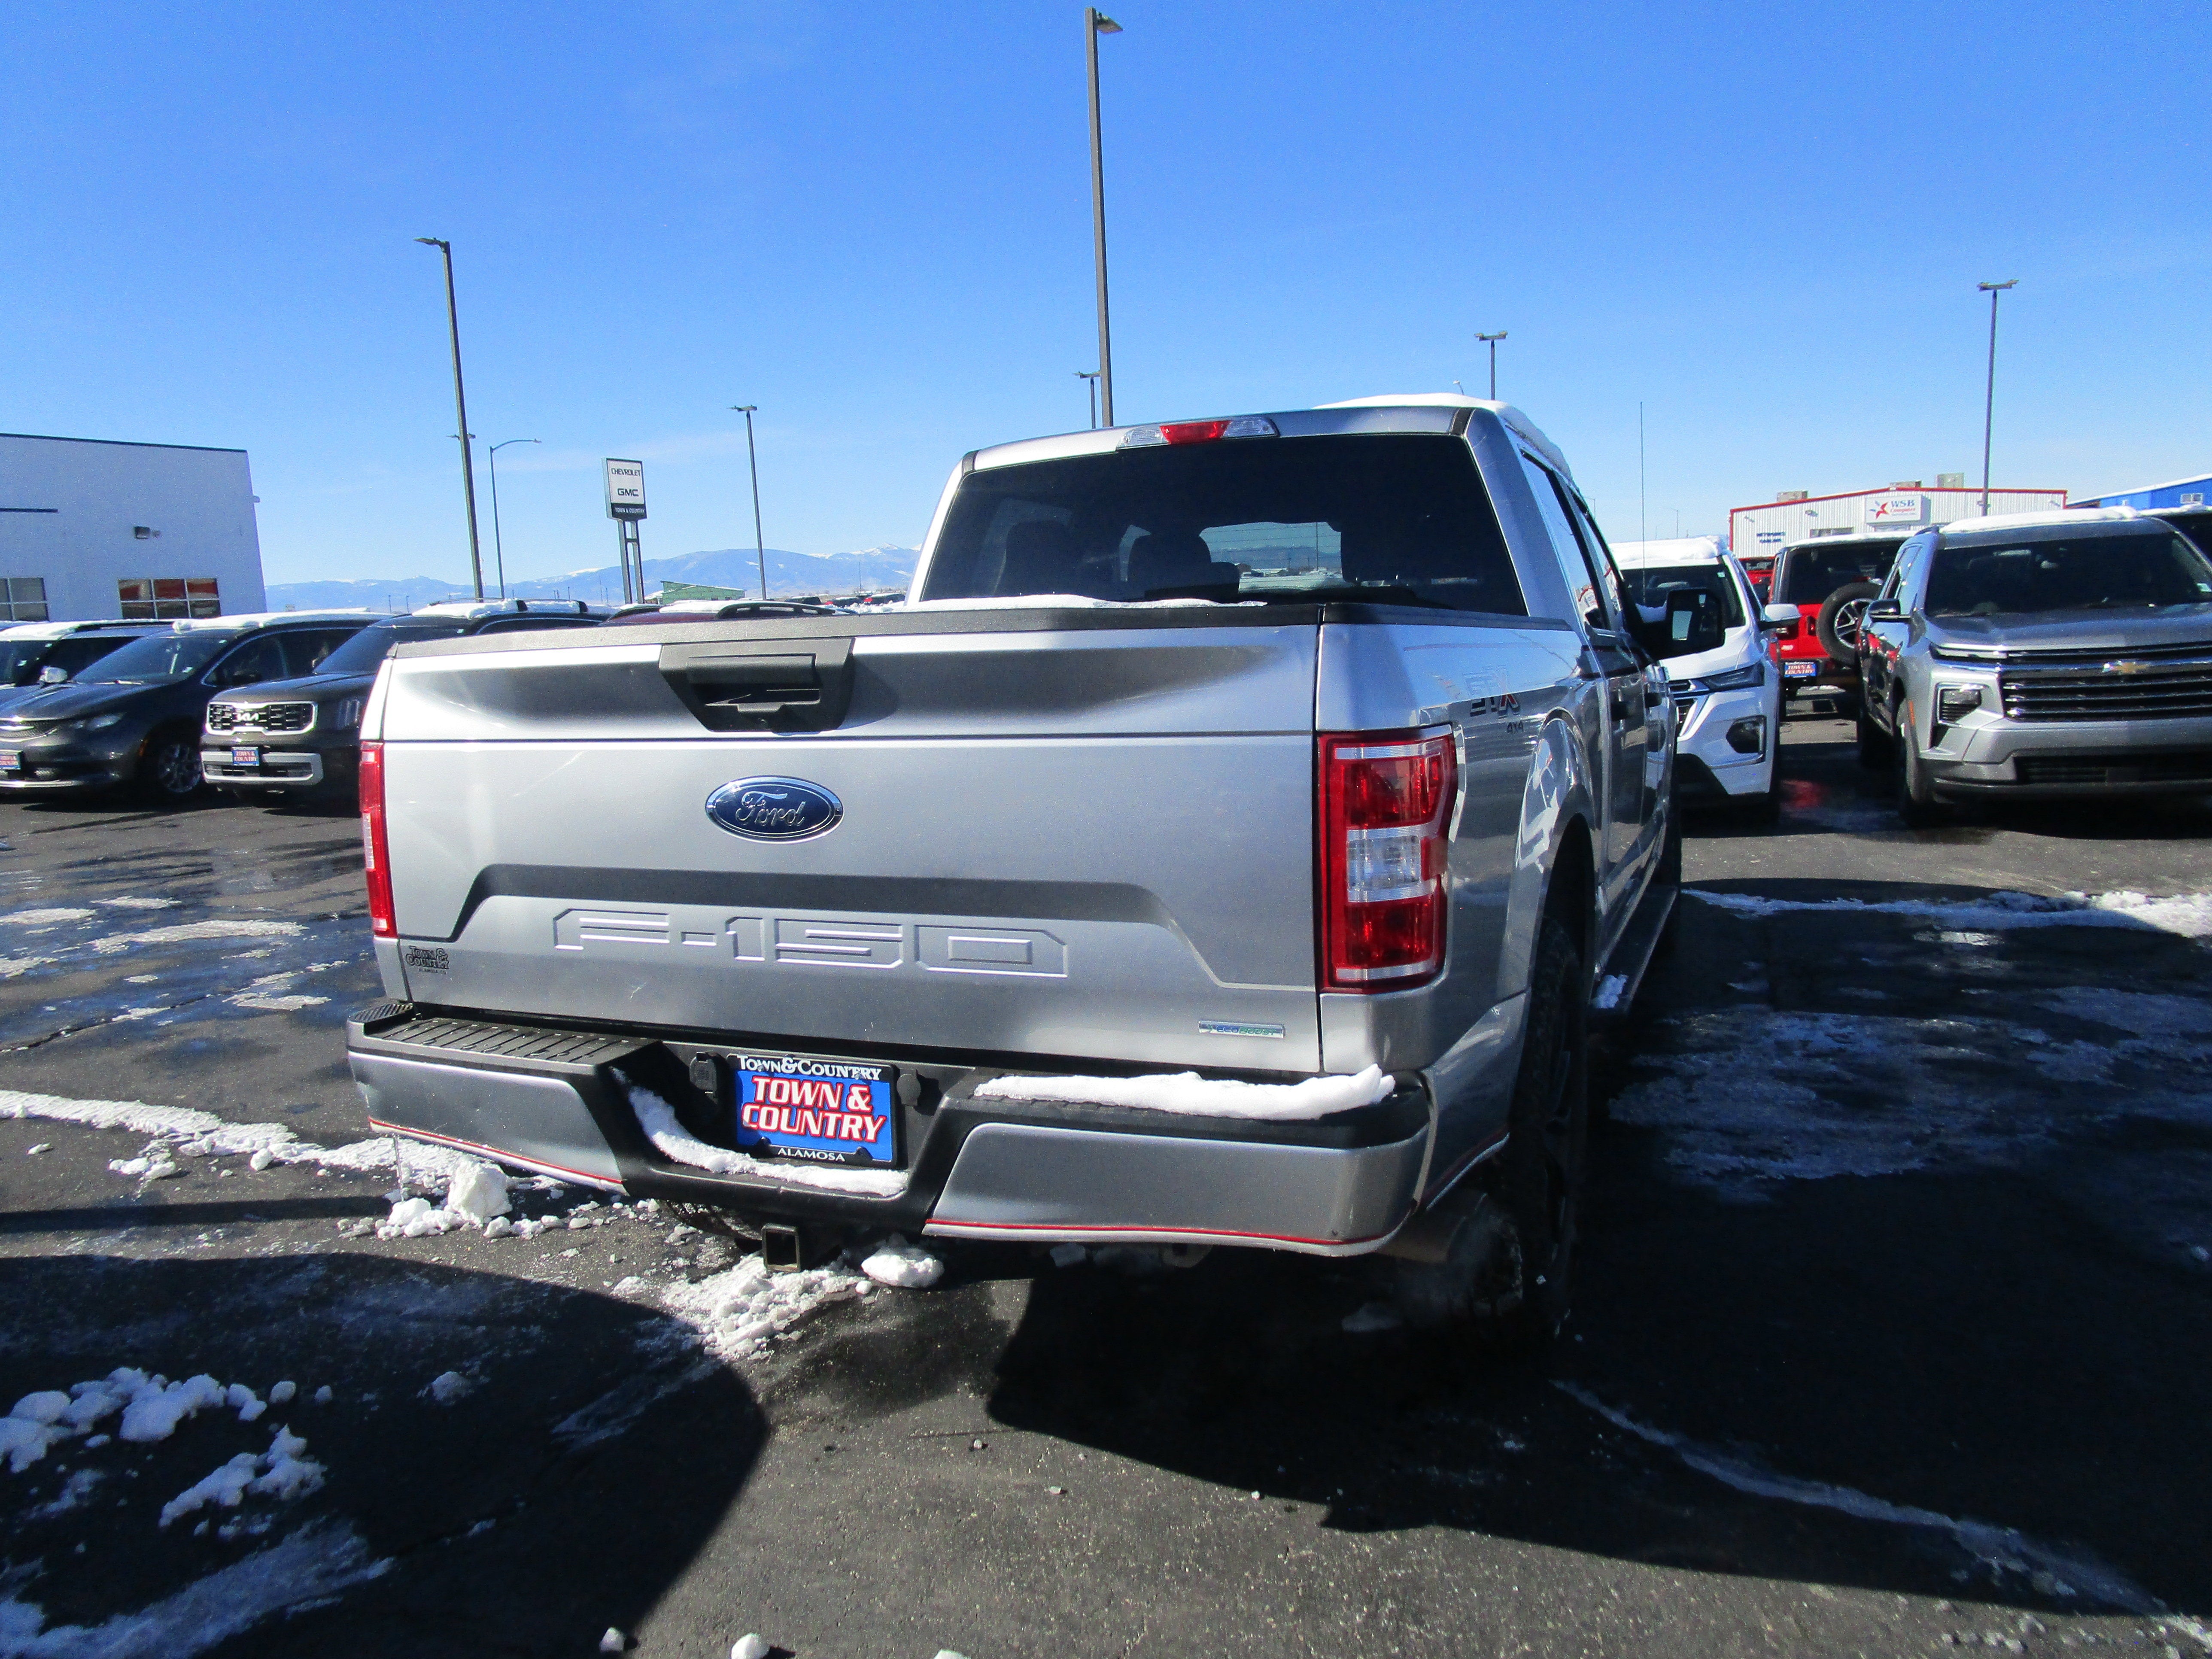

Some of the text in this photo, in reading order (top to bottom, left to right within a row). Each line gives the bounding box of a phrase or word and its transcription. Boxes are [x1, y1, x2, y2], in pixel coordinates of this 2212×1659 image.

[611, 468, 641, 476] CHEVROLET
[617, 488, 639, 496] GMC
[735, 791, 806, 826] Ford
[552, 908, 1069, 978] F-150
[752, 1075, 873, 1113] TOWN &
[741, 1102, 887, 1143] COUNTRY
[778, 1147, 846, 1162] ALAMOSA
